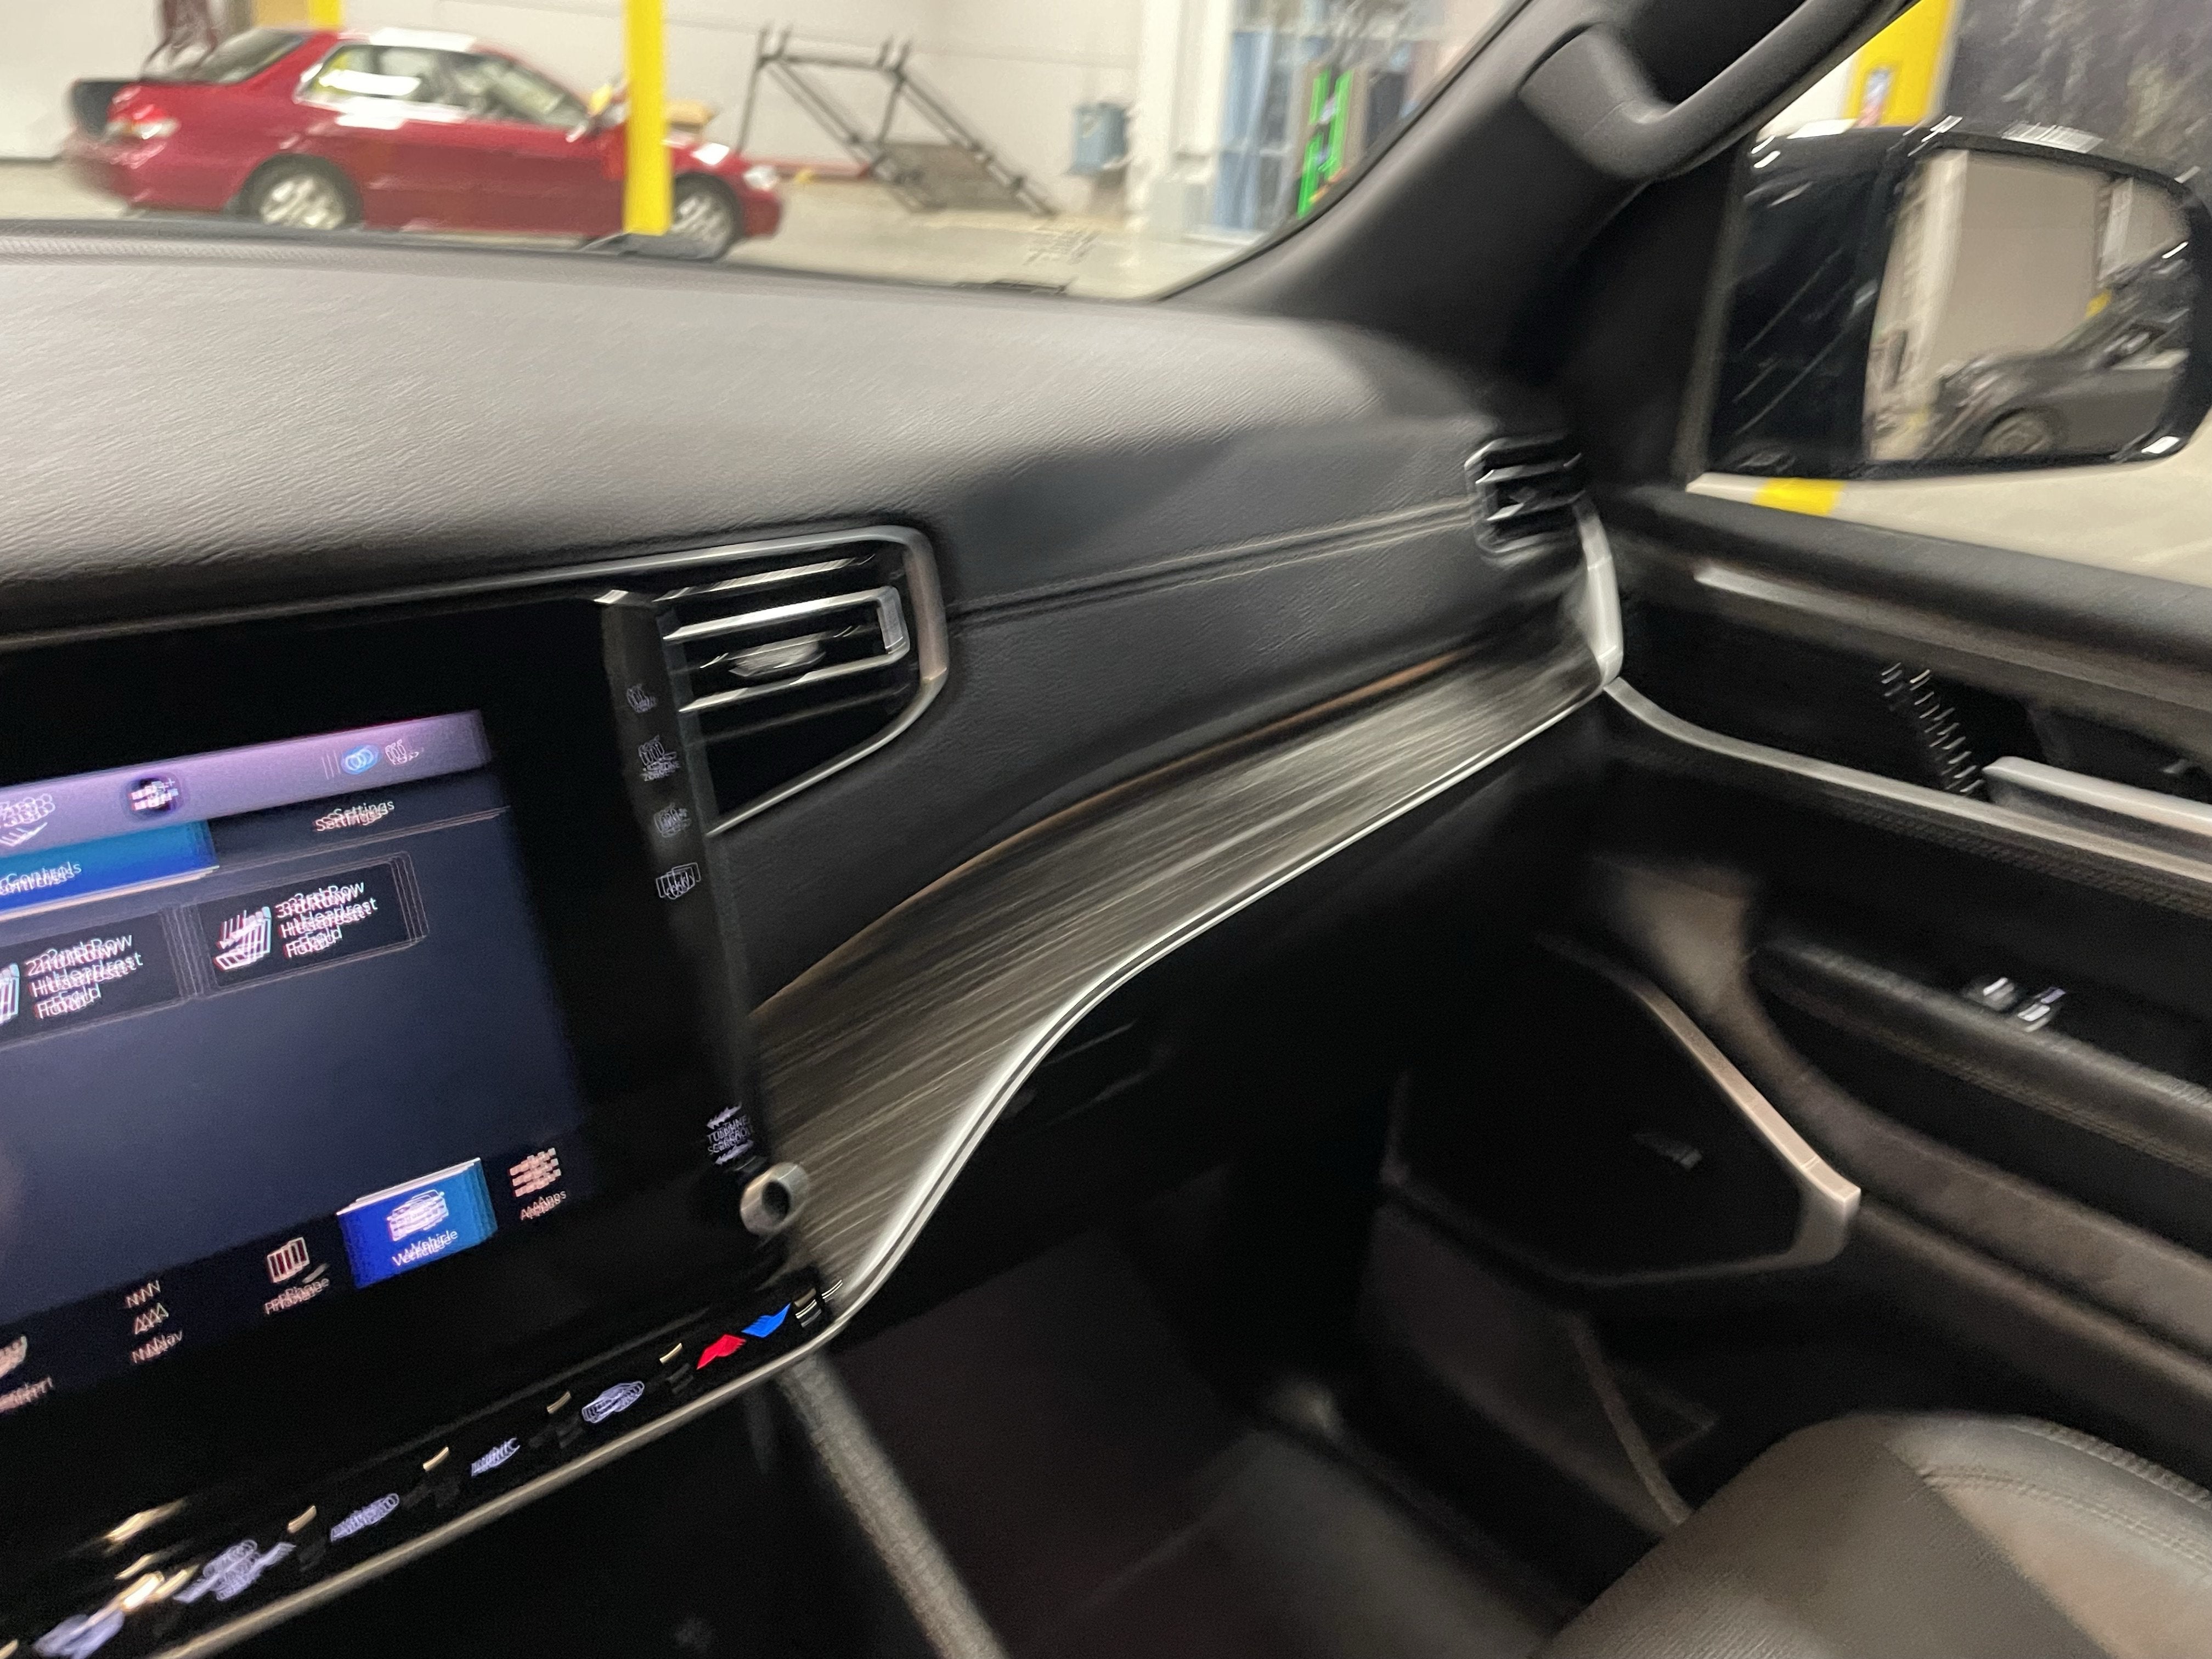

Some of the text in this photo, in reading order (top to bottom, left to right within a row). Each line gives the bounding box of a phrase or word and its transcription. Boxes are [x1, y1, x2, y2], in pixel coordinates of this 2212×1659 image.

[313, 801, 395, 831] Settings
[520, 1190, 567, 1220] Apps
[392, 1230, 458, 1266] Vehicle
